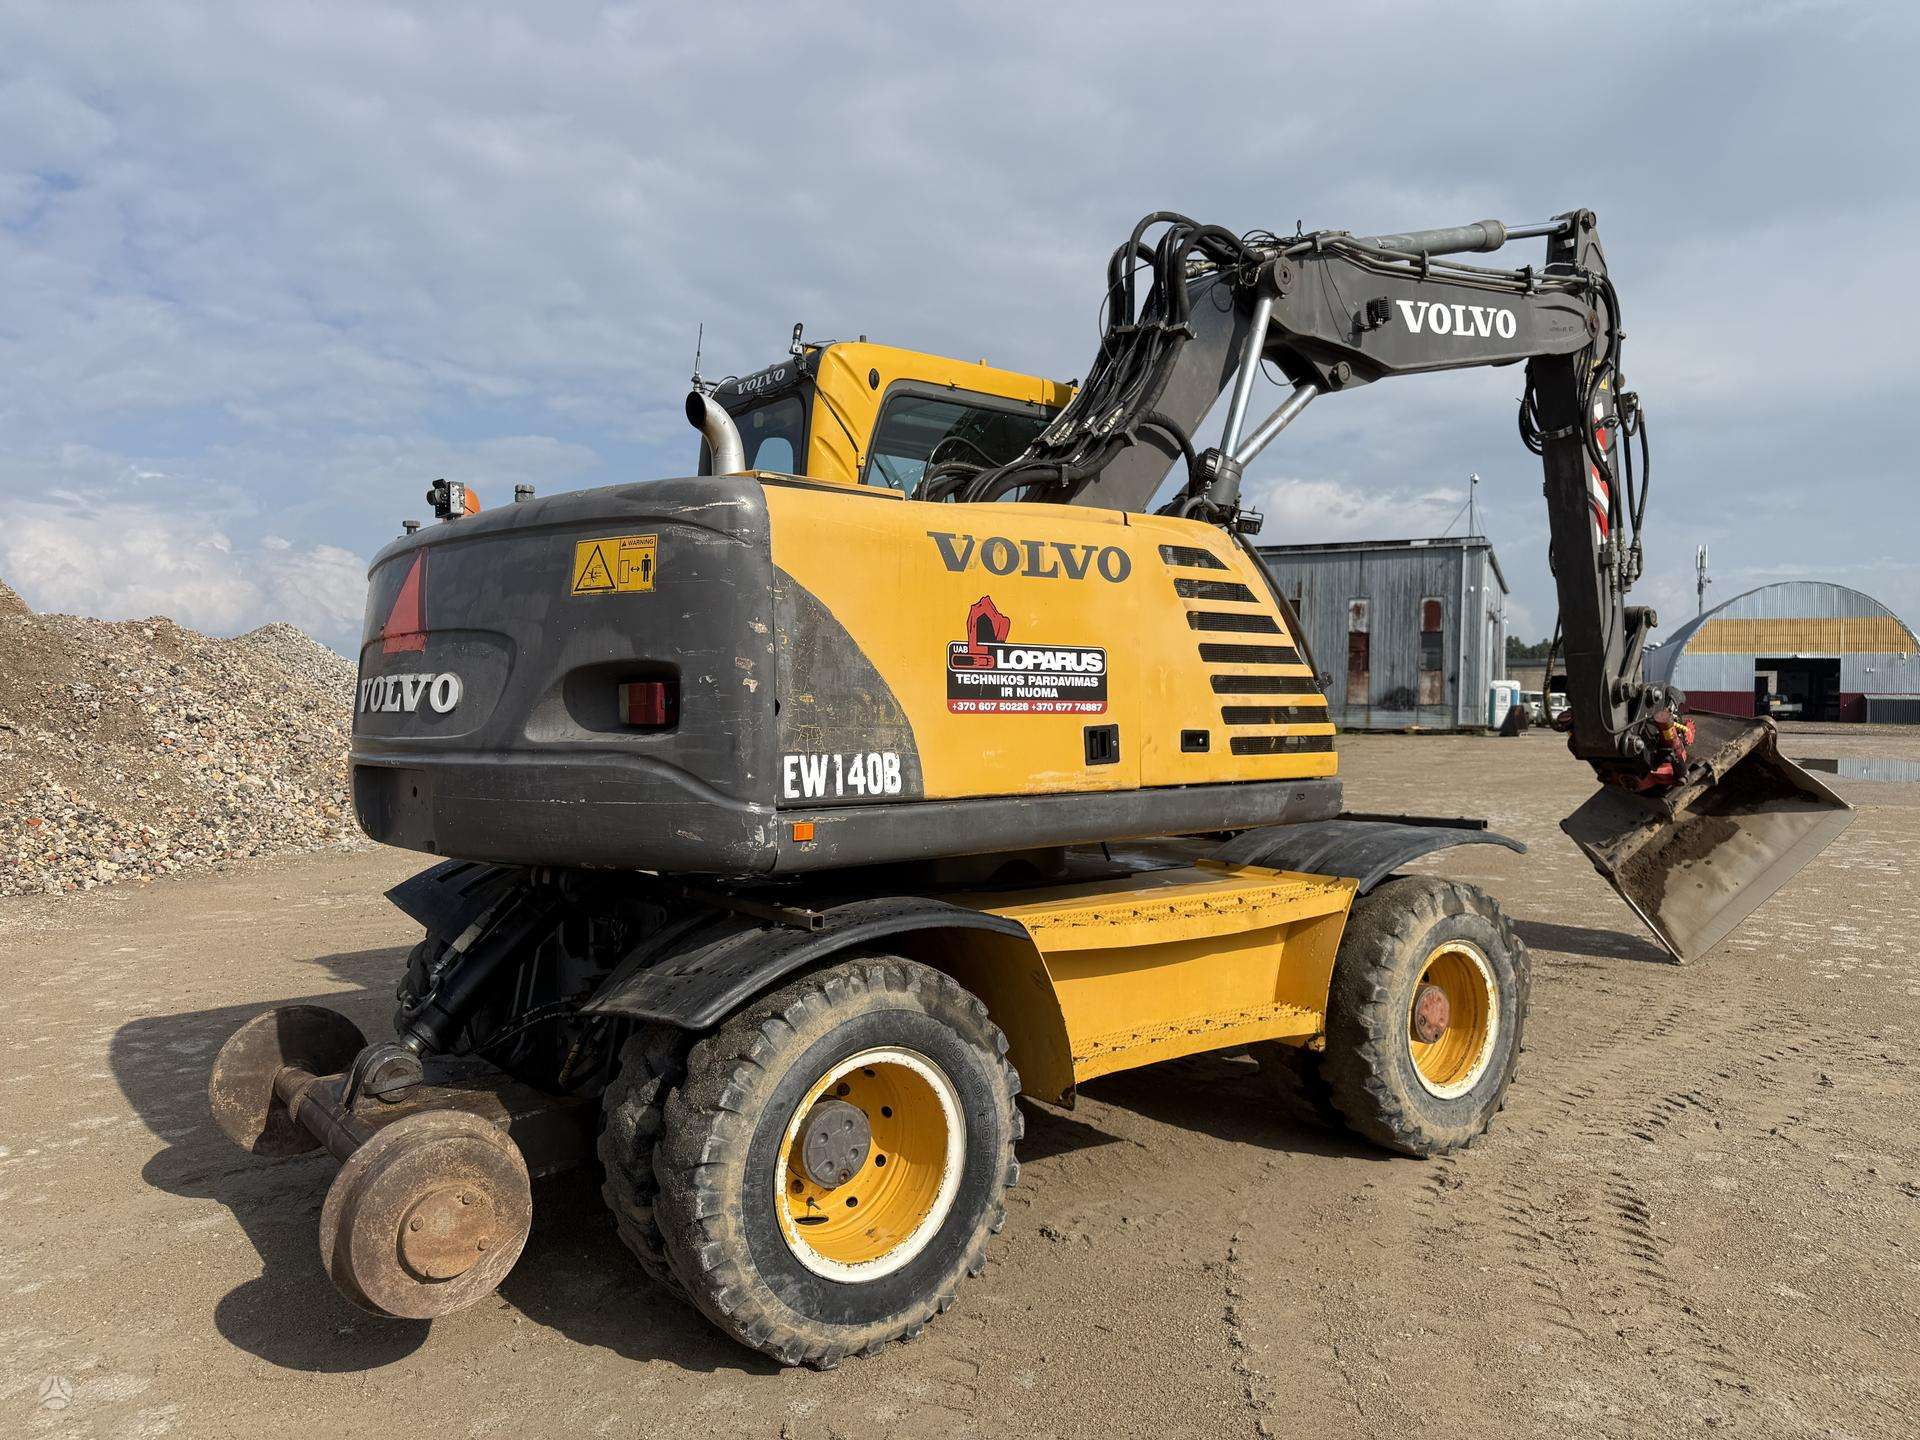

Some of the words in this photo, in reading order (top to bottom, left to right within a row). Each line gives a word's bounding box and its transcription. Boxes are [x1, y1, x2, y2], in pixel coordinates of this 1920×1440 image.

[1396, 299, 1517, 338] VOLVO
[737, 368, 786, 395] VOLVO
[627, 538, 654, 546] WARNING
[926, 530, 1132, 583] VOLVO
[953, 645, 968, 654] UAB
[996, 649, 1103, 672] LOPARUS
[955, 673, 1025, 686] TECHNIKOS
[1028, 676, 1099, 688] PARDAVIMAS
[360, 672, 464, 713] VOLVO
[1001, 687, 1013, 698] IR
[1016, 687, 1059, 698] NUOMA
[952, 702, 976, 711] +370
[978, 702, 997, 711] 607
[1031, 703, 1053, 712] +370
[1055, 703, 1073, 712] 677
[783, 752, 902, 799] EW140B
